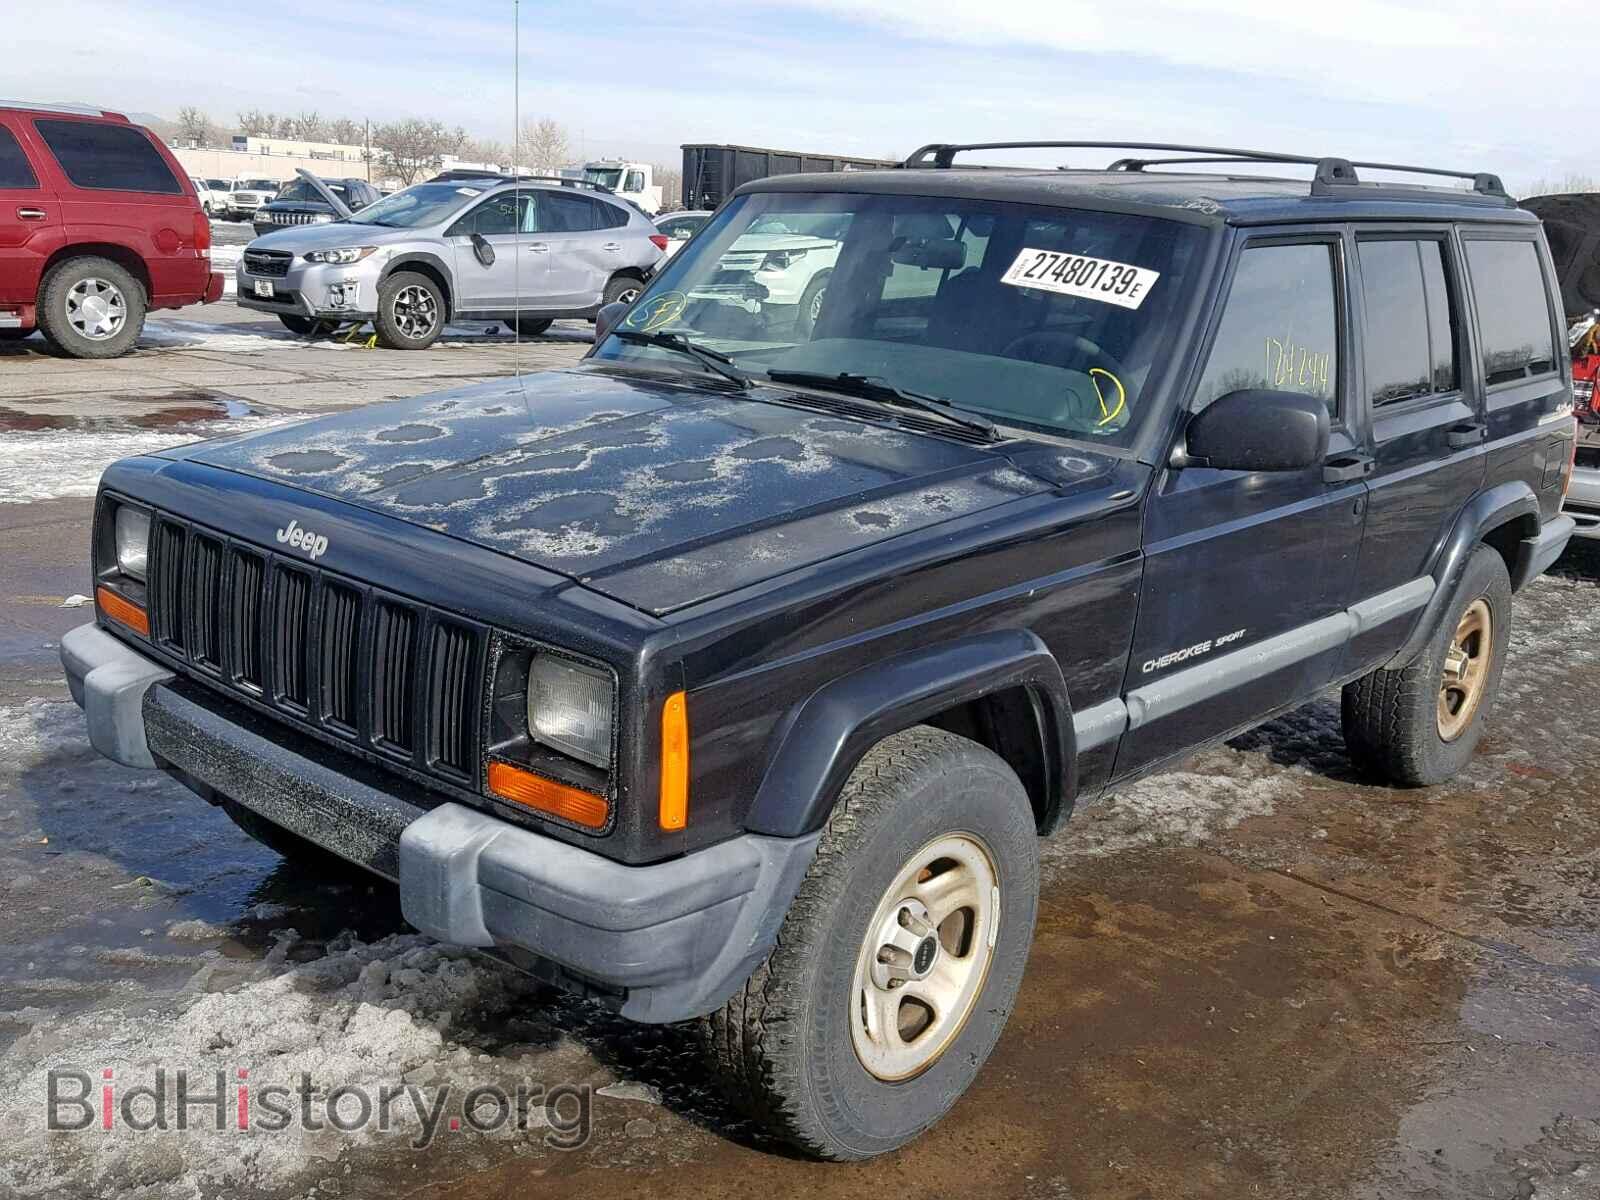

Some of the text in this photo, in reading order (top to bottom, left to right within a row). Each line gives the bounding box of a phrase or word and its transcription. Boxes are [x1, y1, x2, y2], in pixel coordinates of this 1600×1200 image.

[276, 520, 329, 560] Jeep
[1142, 628, 1247, 673] CHEROKEE SPORT
